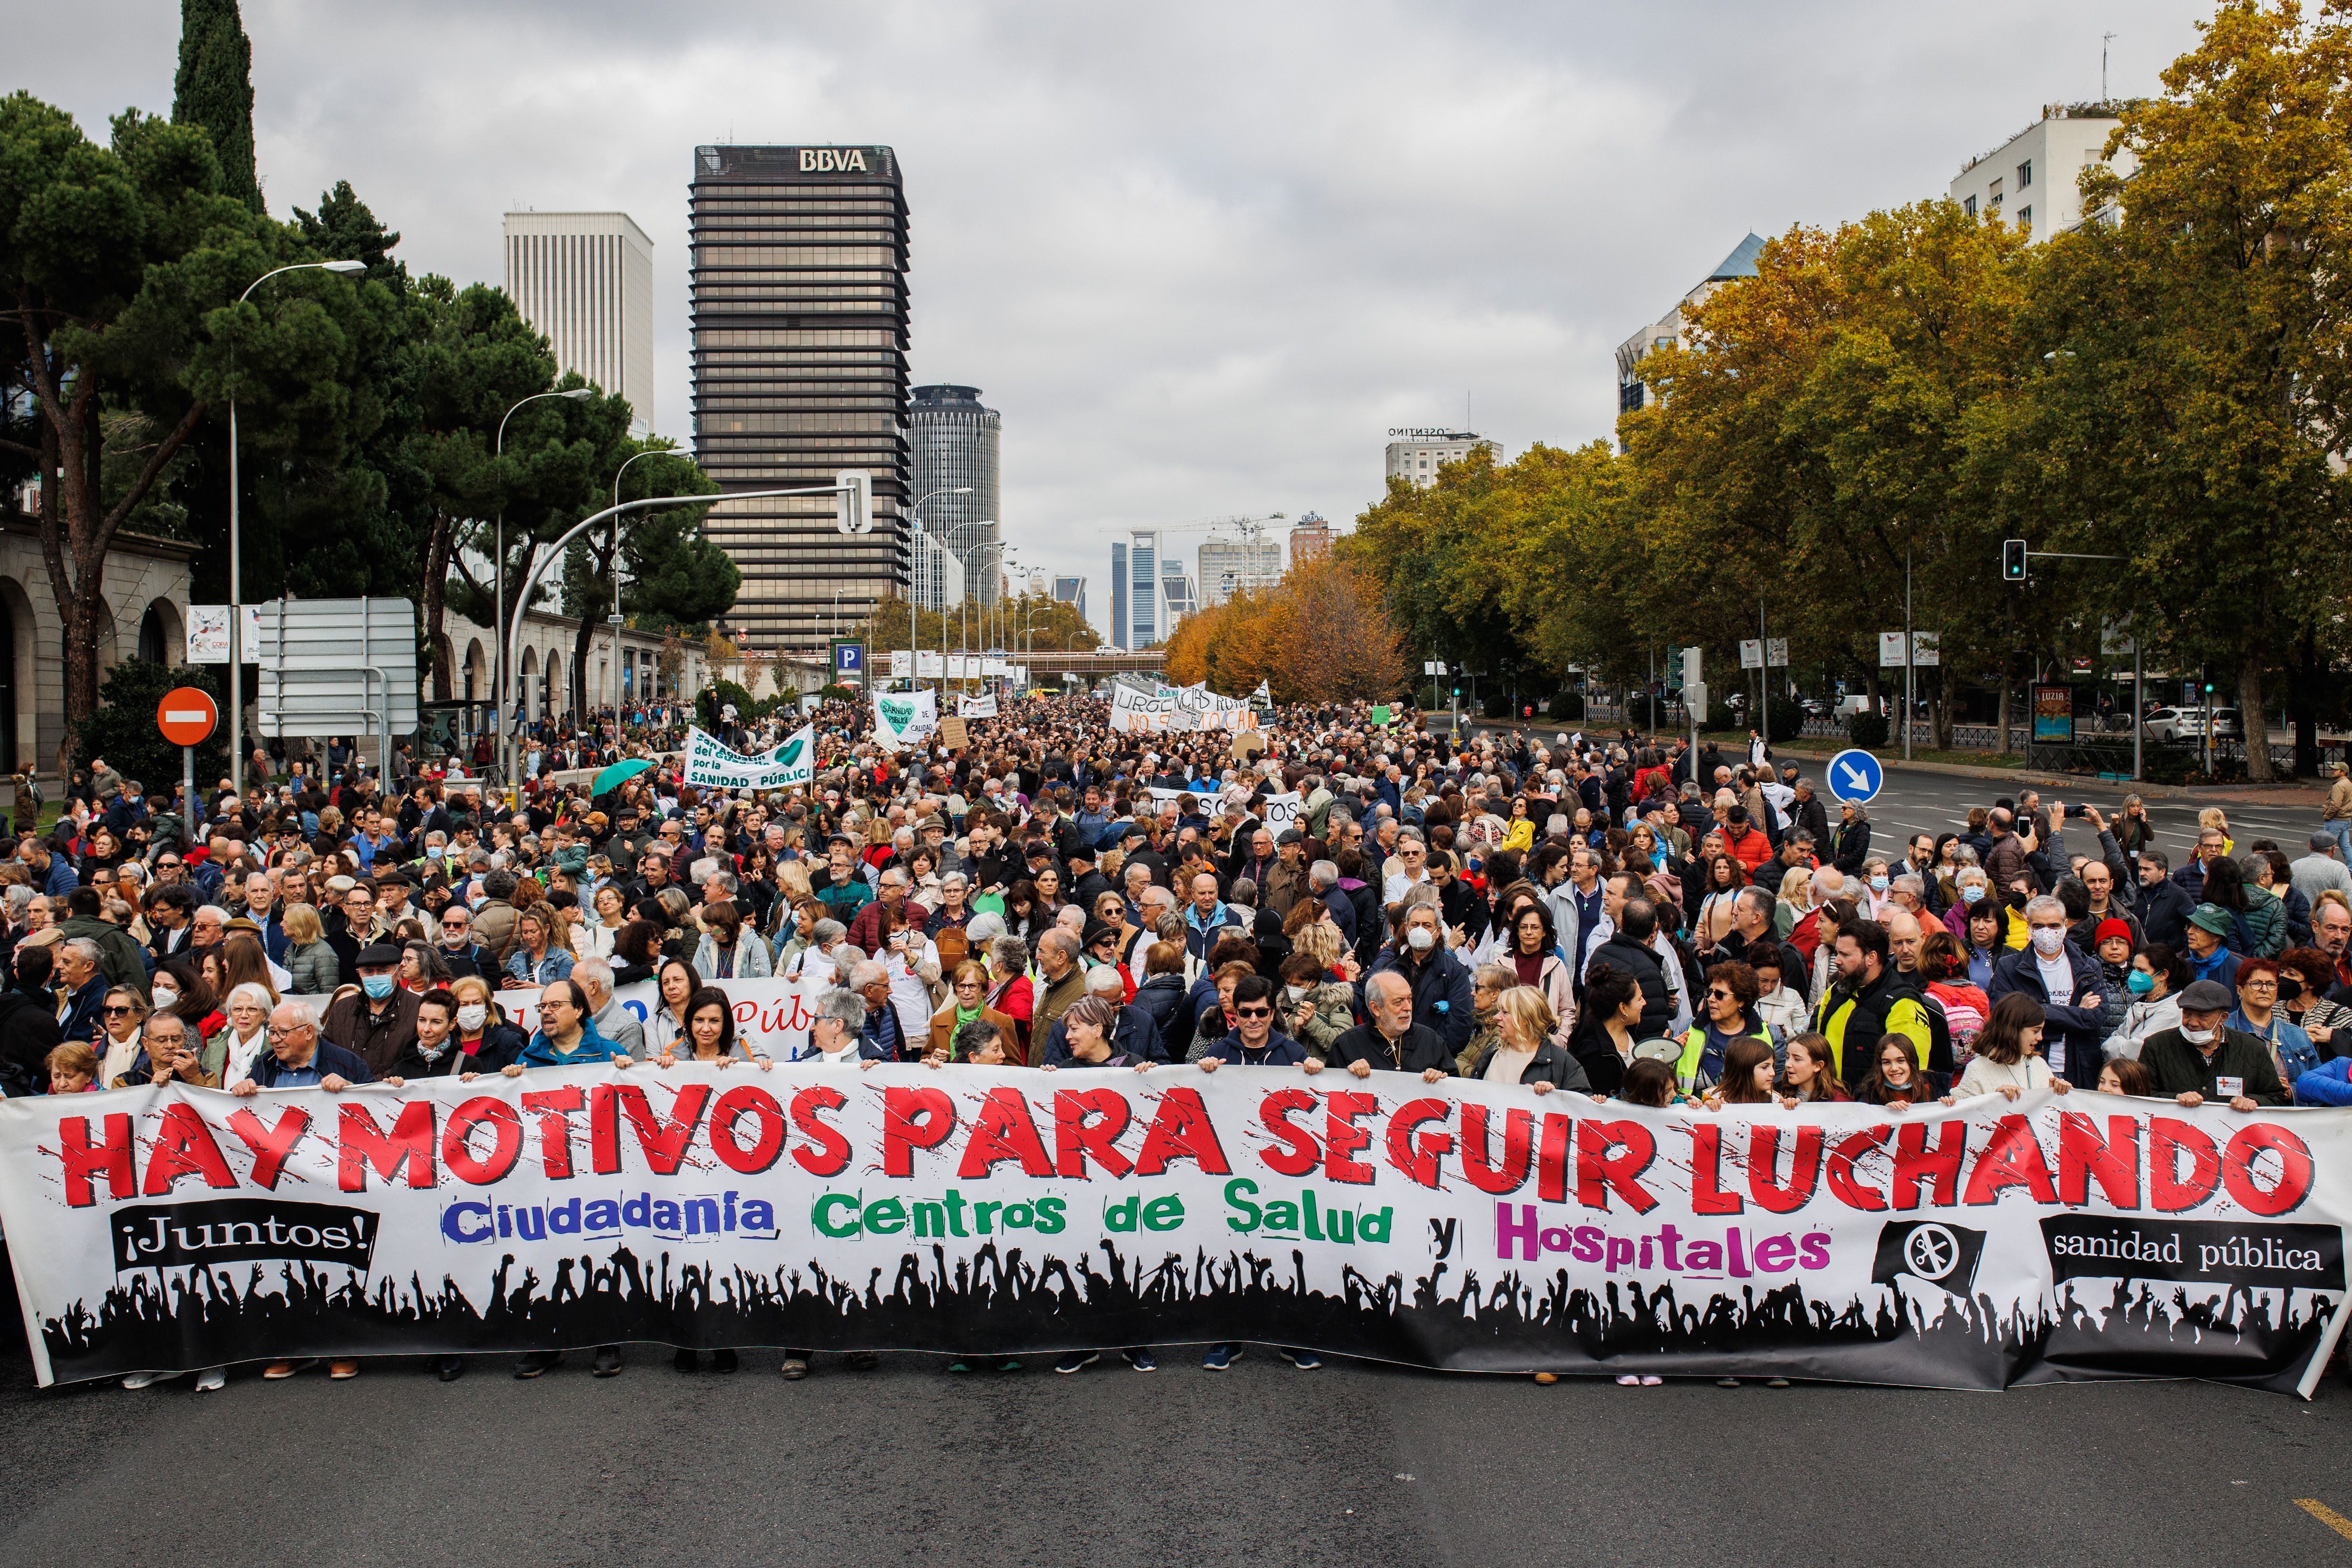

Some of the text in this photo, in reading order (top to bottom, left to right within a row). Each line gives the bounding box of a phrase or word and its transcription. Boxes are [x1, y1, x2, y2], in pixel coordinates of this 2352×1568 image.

[799, 149, 867, 171] BBVA
[844, 650, 855, 667] P
[2042, 693, 2063, 701] LUZIA
[1129, 713, 1149, 731] NO
[696, 734, 717, 750] San
[695, 745, 712, 757] del
[693, 759, 721, 770] por la
[691, 771, 749, 787] SANIDAD
[59, 1083, 2315, 1217] HAY MOTIVOS PARA SEGUIR LUCHANDO
[812, 1187, 1067, 1241] Centros
[1102, 1193, 1185, 1239] de
[1223, 1178, 1394, 1244] Salud
[1429, 1217, 1456, 1260] y
[1495, 1201, 1832, 1279] Hospitales
[122, 1215, 368, 1262] ¡Juntos!
[2053, 1229, 2324, 1272] sanidad pública
